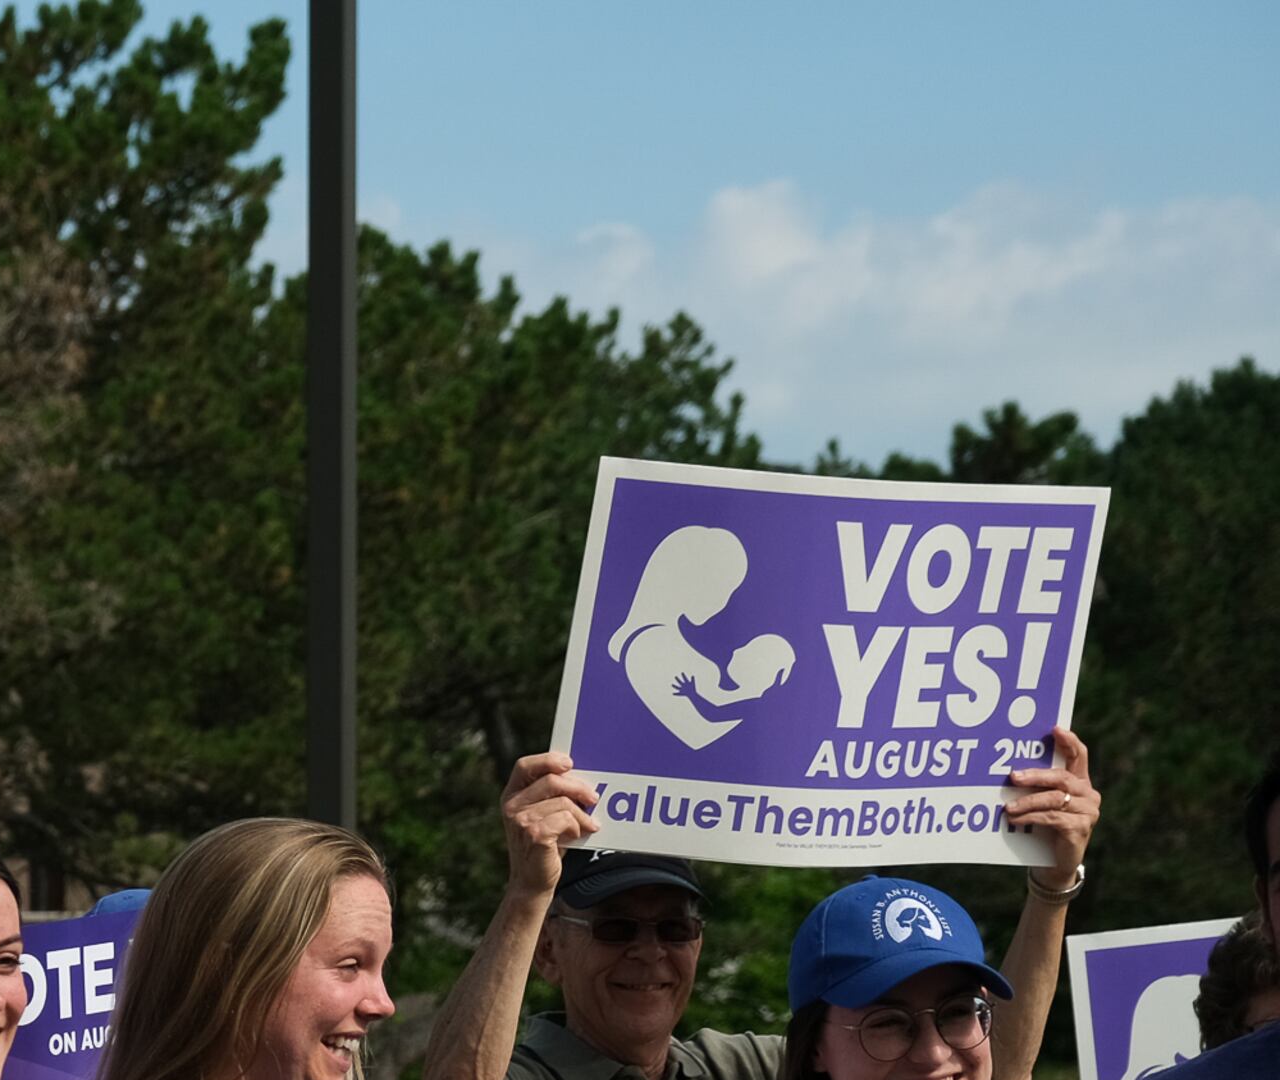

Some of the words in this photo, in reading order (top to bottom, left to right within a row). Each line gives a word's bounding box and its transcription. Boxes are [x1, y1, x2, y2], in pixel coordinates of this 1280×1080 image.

[836, 520, 1075, 614] VOTE
[822, 621, 1053, 729] YES!
[805, 738, 979, 780] AUGUST
[988, 737, 1045, 776] 2ND
[872, 909, 884, 940] SUSAN
[885, 888, 941, 915] ANTHONY
[938, 916, 953, 937] LIST
[49, 1026, 76, 1056] ON
